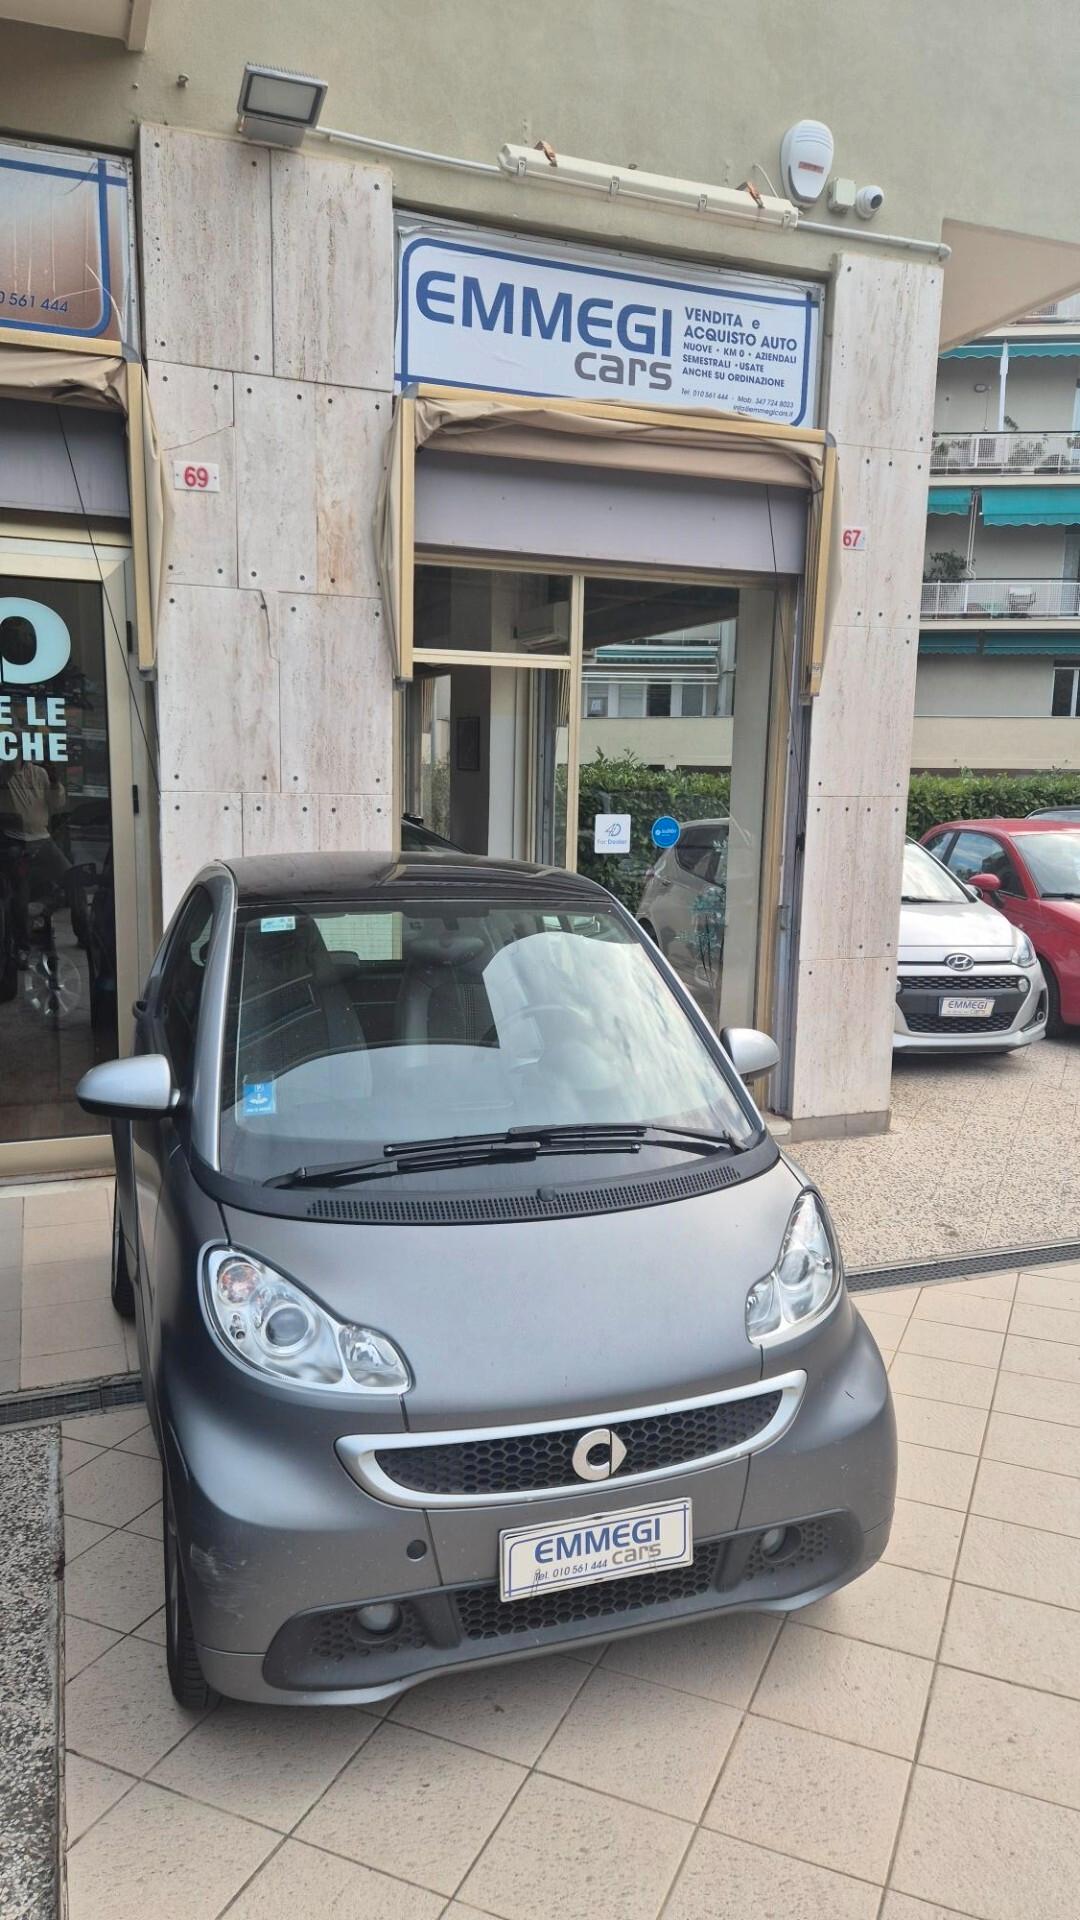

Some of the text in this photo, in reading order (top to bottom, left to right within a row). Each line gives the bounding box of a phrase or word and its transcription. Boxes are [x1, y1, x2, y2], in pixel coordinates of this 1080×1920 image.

[8, 293, 35, 308] 561
[40, 297, 69, 313] 444
[415, 269, 673, 358] EMMEGI
[684, 306, 761, 330] VENDITA e
[683, 325, 798, 351] ACQUISTO AUTO
[682, 354, 764, 373] SEMESTRALI USATE
[683, 342, 797, 364] NUOVE KM 0 AZIENDALI
[574, 350, 673, 391] cars
[682, 367, 785, 388] ANCHE SU ORDINAZIONE
[184, 466, 209, 488] 69
[842, 530, 862, 547] 67
[26, 696, 68, 727] LE
[948, 1000, 988, 1009] EMMEGI
[534, 1517, 661, 1565] EMMEGI
[552, 1566, 571, 1579] 010
[572, 1563, 588, 1575] 561
[590, 1559, 608, 1571] 444
[611, 1543, 662, 1565] cars
